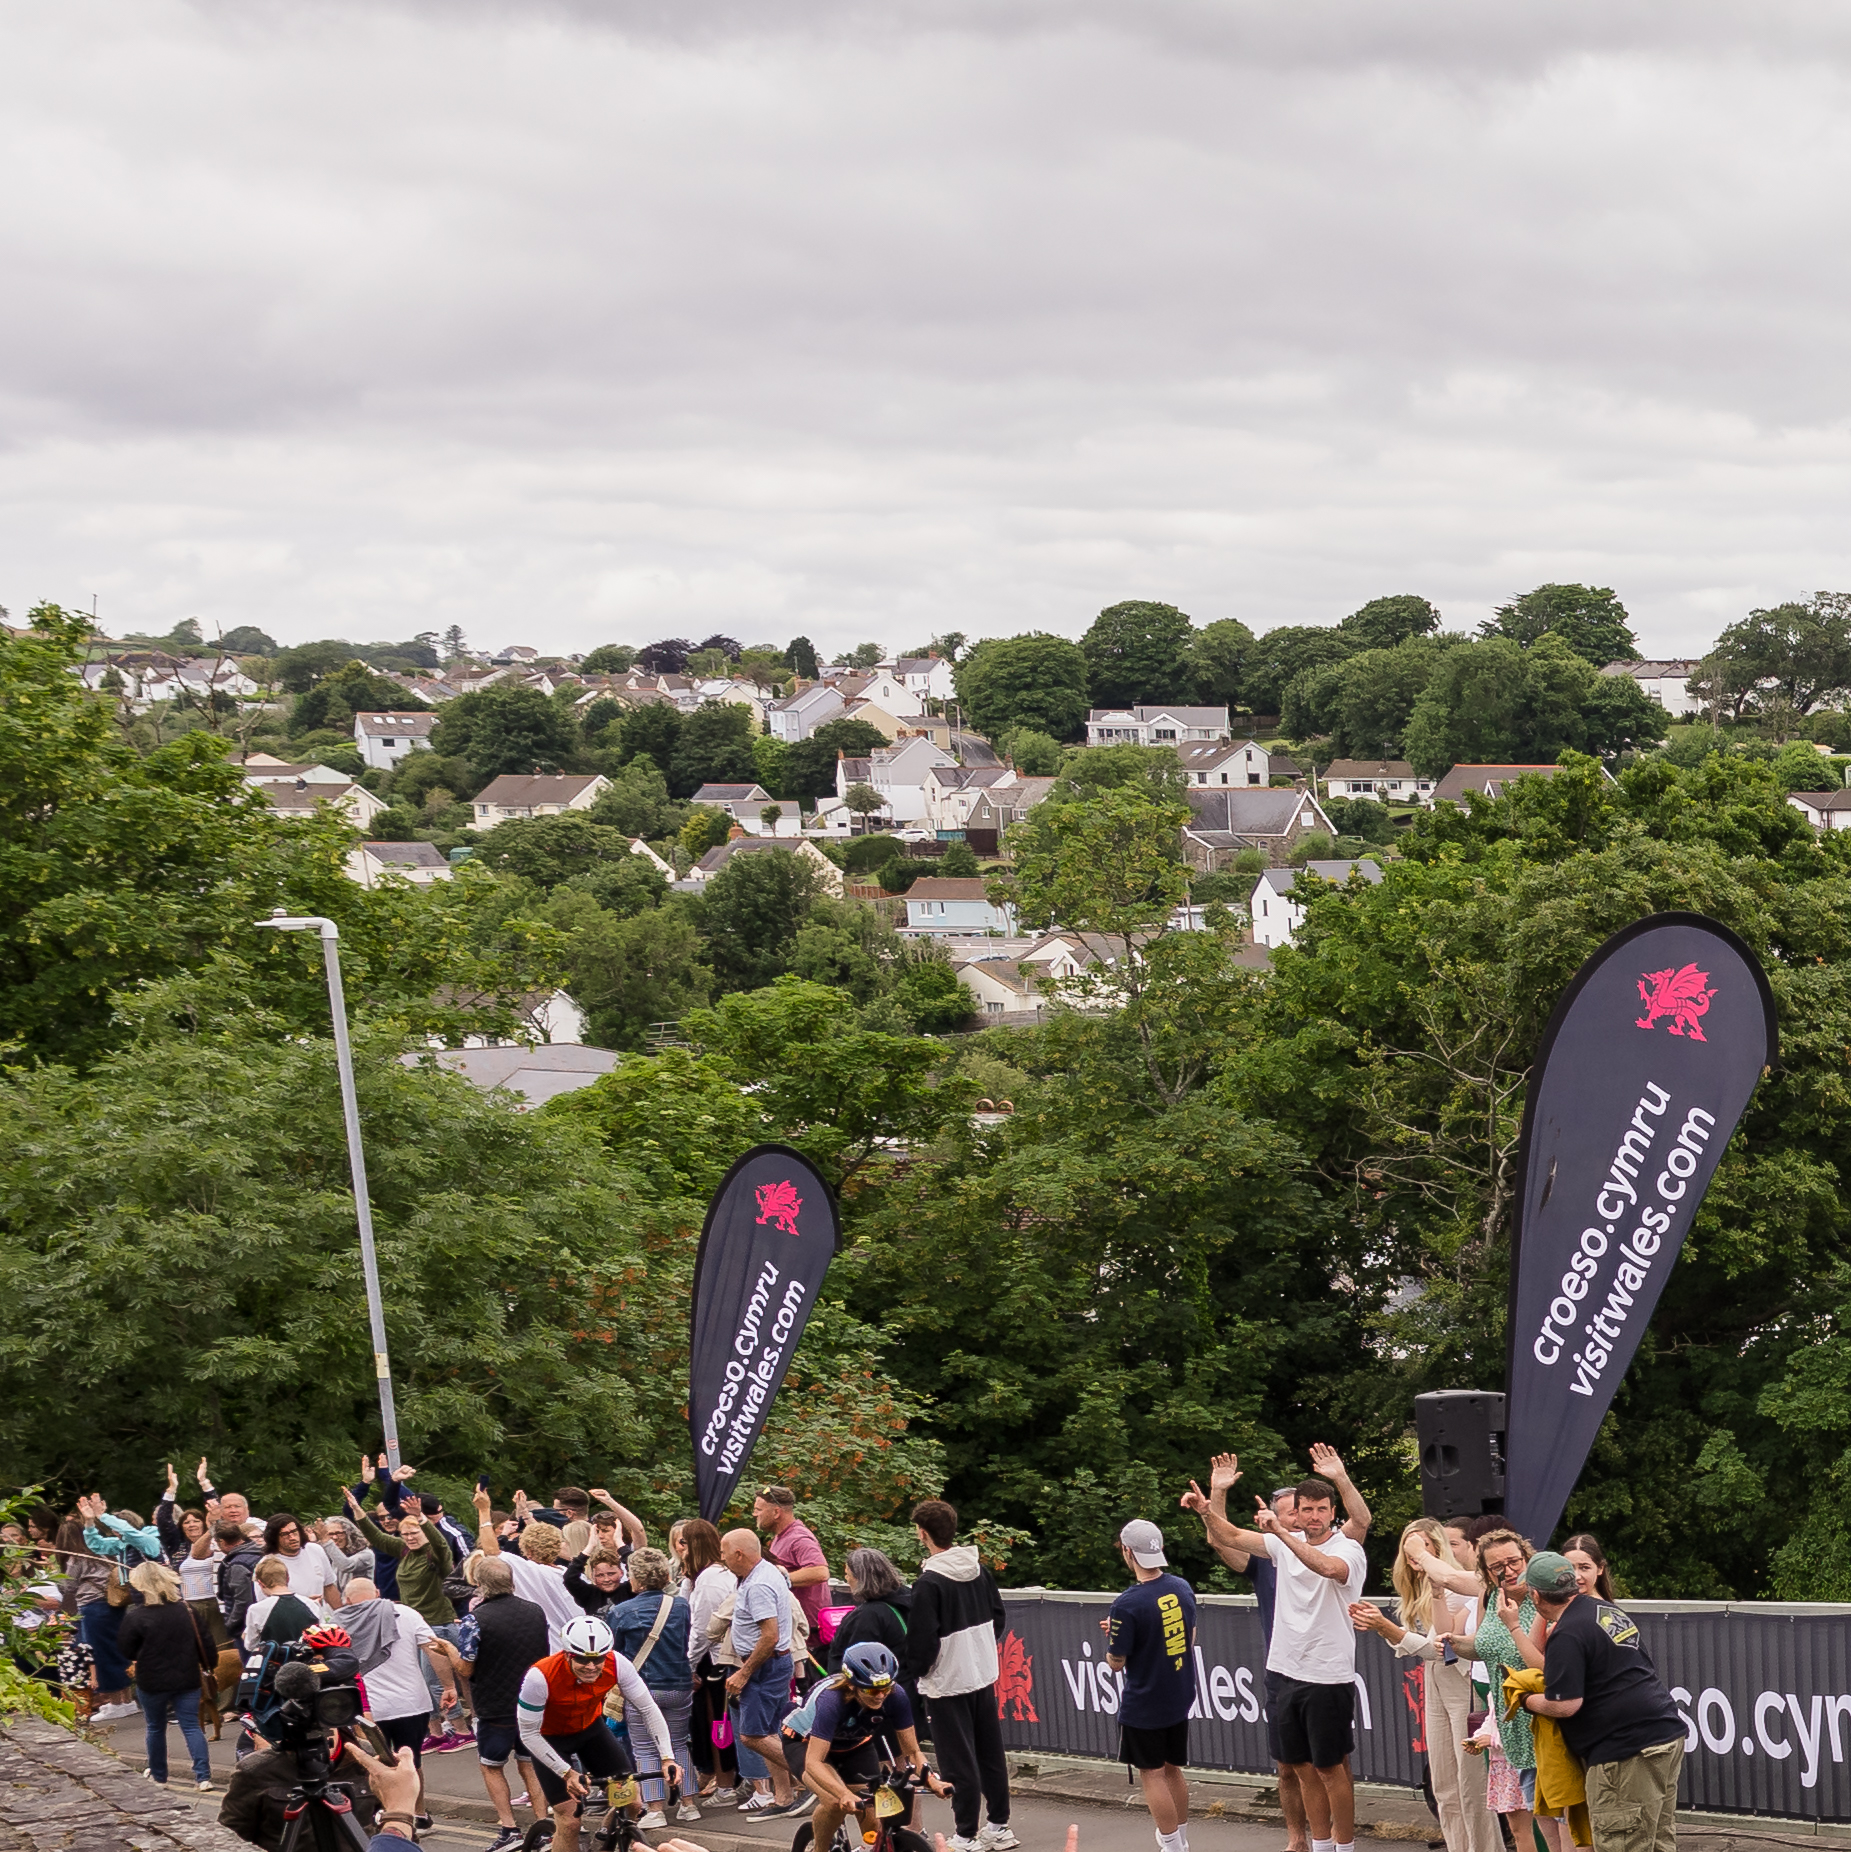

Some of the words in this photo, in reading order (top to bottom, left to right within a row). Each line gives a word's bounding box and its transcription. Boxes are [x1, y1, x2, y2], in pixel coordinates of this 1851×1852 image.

[1533, 1081, 1672, 1368] croeso.cymru
[1569, 1104, 1717, 1398] visitwales.com
[700, 1260, 781, 1460] croeso.cymru
[716, 1279, 806, 1476] visitwales.com
[1157, 1593, 1187, 1656] CREW
